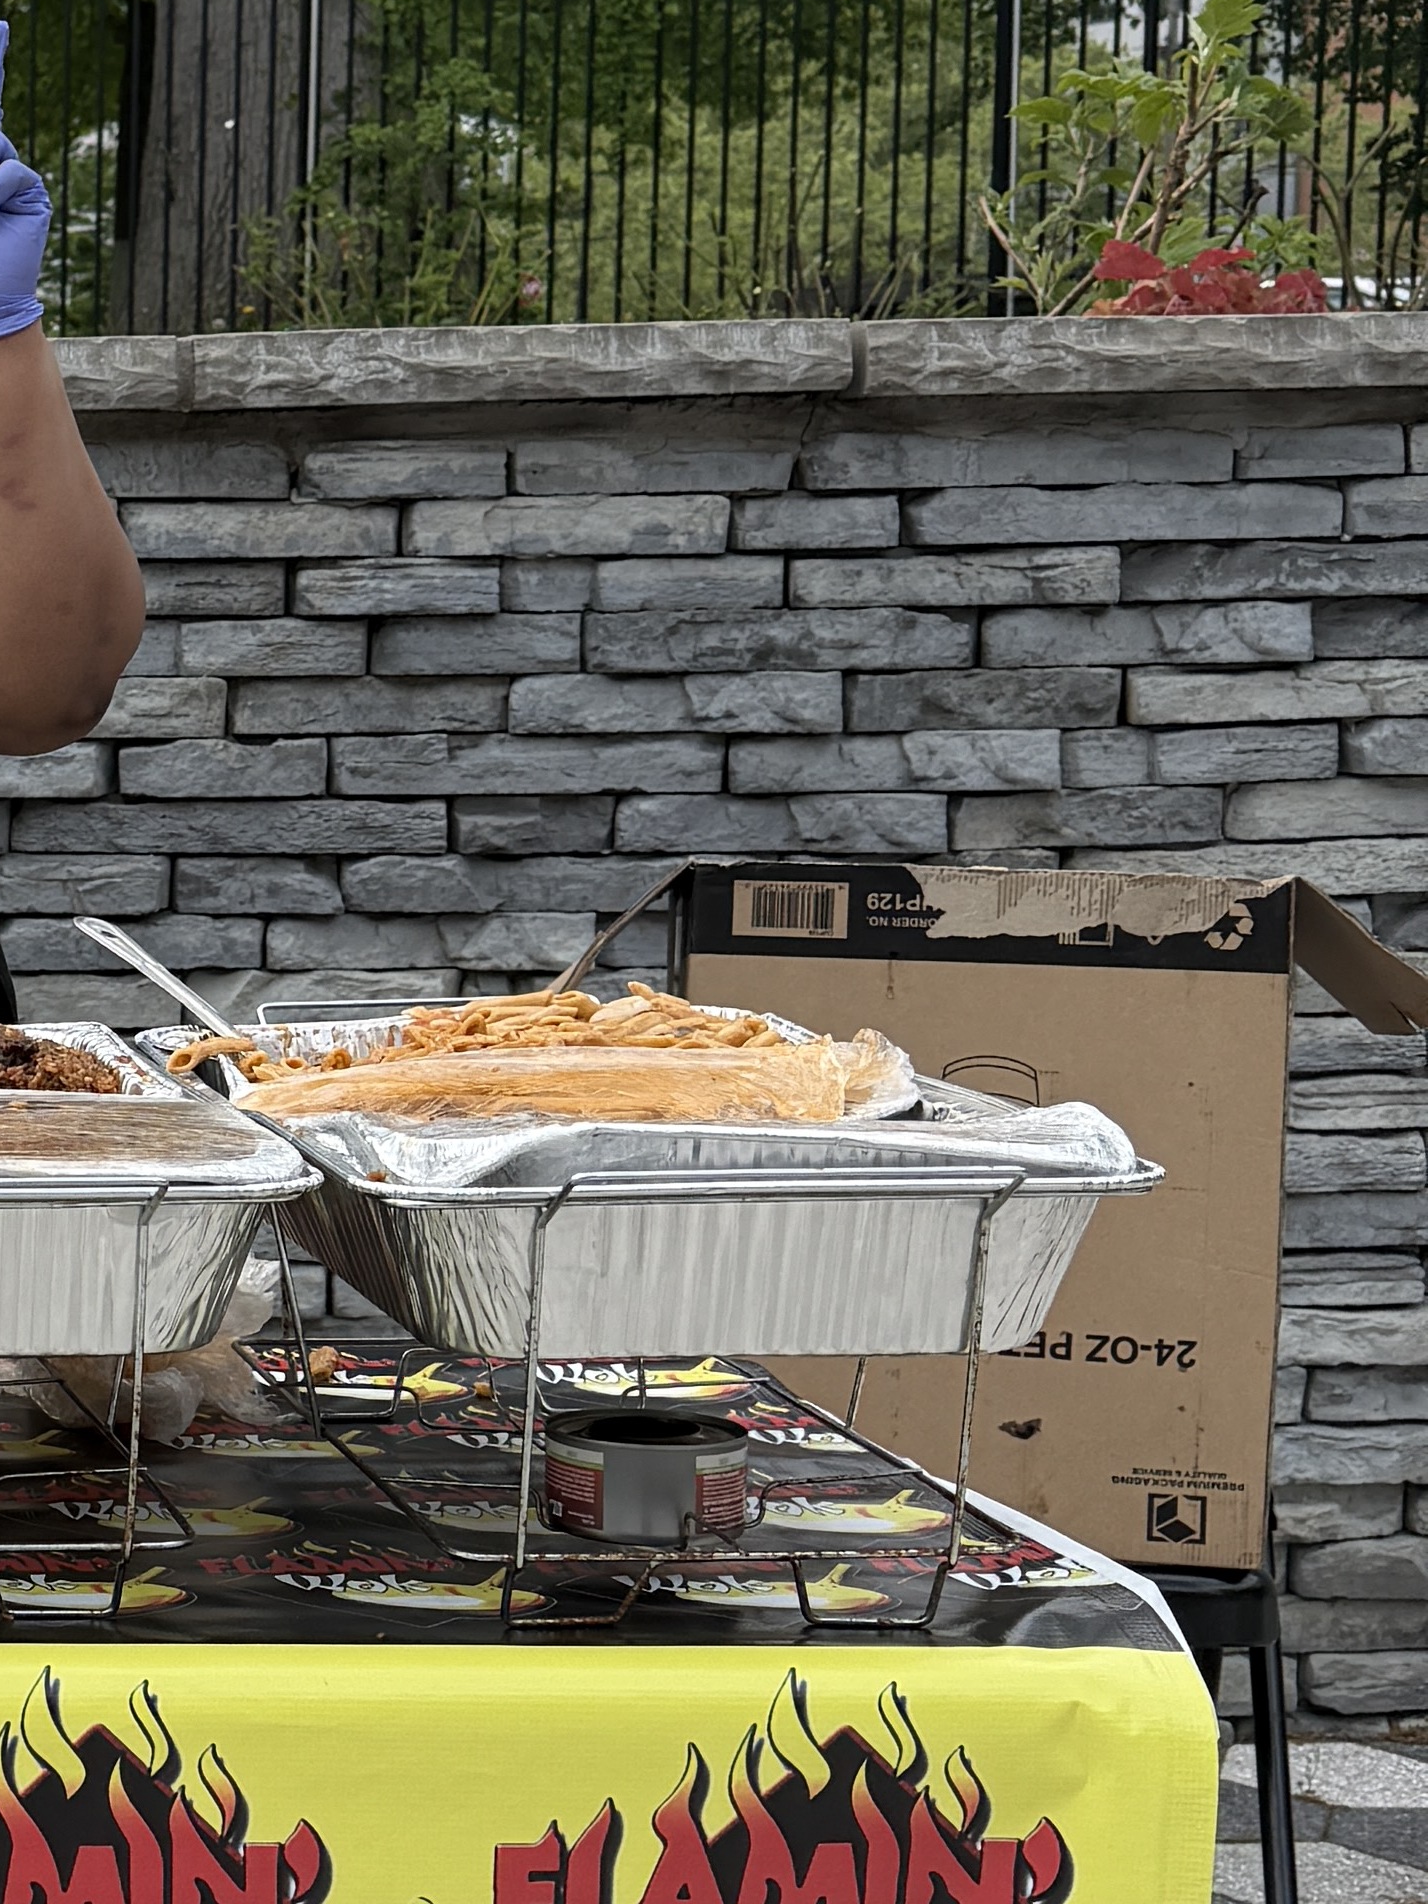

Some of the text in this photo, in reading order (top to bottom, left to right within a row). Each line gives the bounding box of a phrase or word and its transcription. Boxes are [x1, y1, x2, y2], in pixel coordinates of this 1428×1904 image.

[866, 892, 932, 911] P129
[865, 915, 938, 928] ORDER NO.
[1084, 1333, 1198, 1371] 24-OZ
[1111, 1475, 1245, 1492] PREMIUM PACKAGING
[1183, 1470, 1228, 1480] QUALITY
[274, 1573, 434, 1594] Wok
